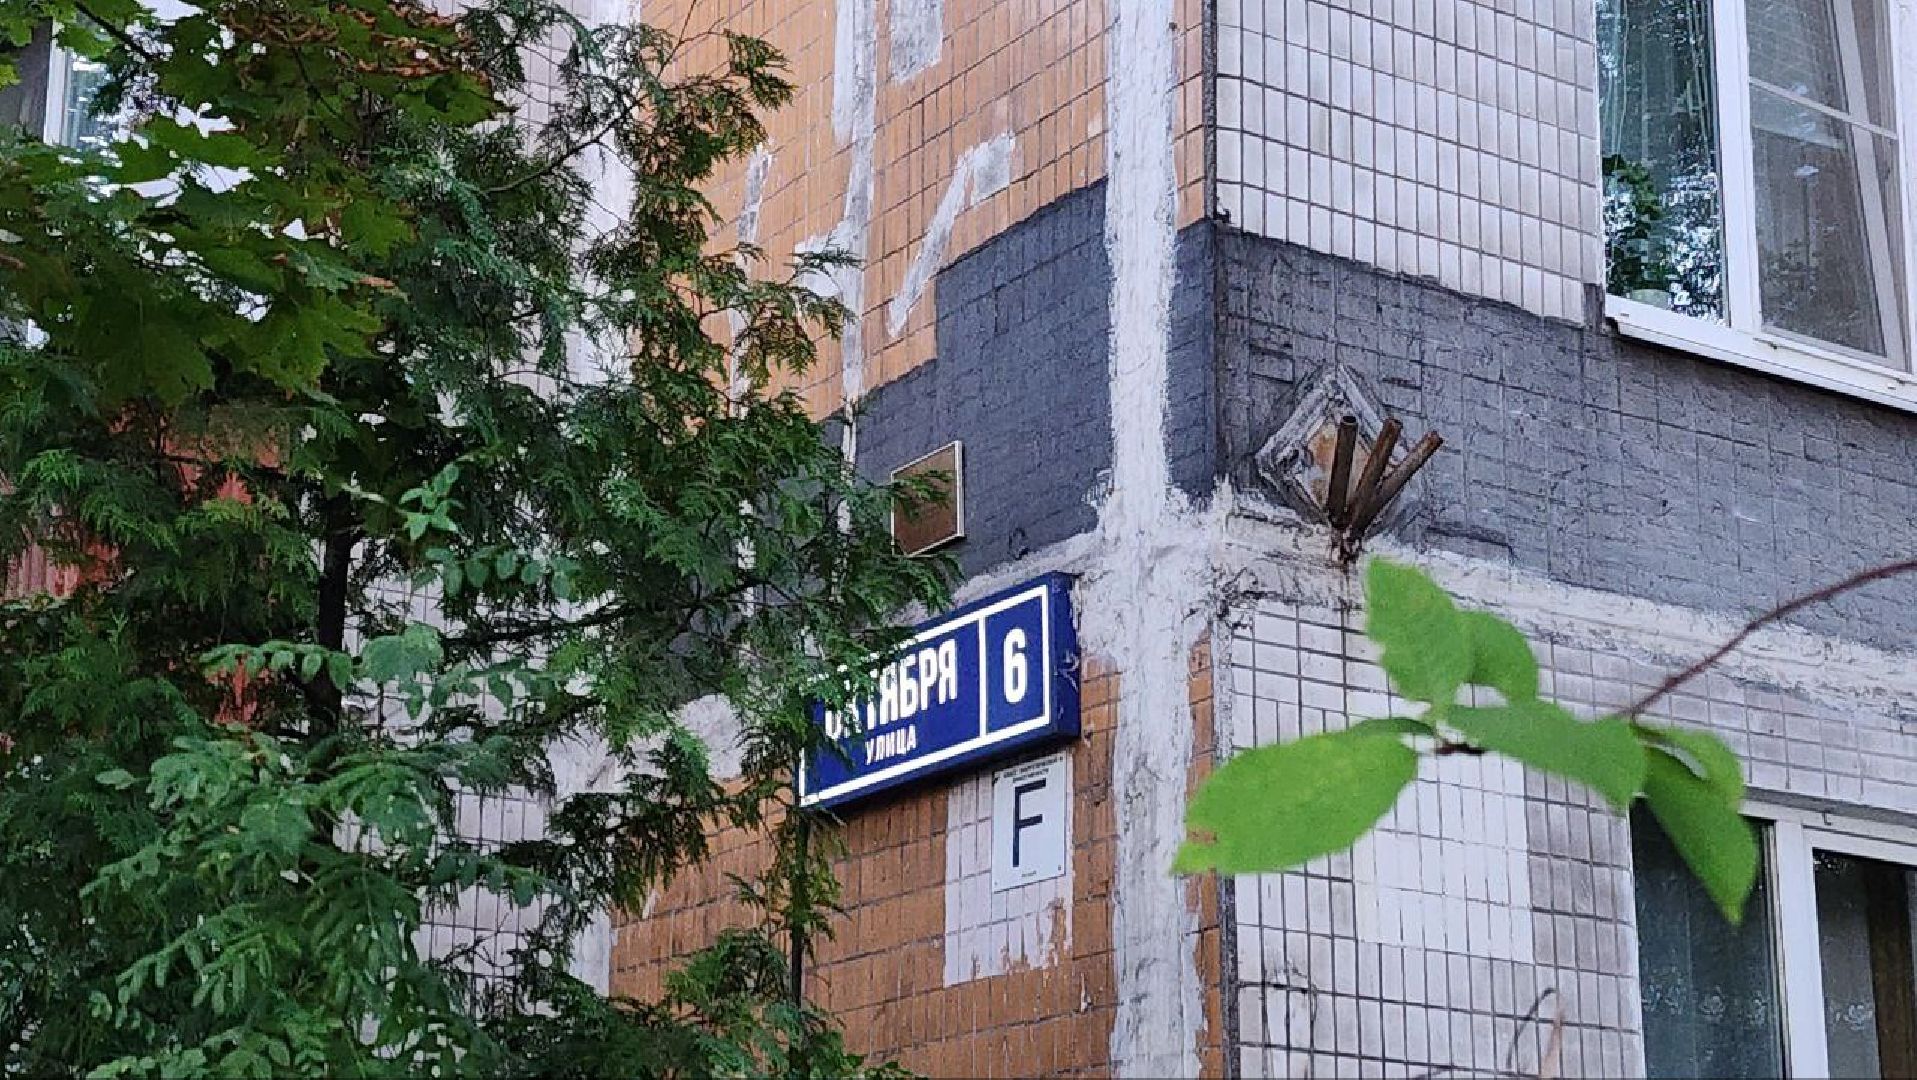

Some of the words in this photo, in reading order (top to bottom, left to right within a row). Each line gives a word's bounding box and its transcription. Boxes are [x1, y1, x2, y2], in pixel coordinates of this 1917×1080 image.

[1003, 626, 1028, 704] 6
[864, 723, 917, 766] УЛИЦА
[1012, 777, 1047, 868] F
